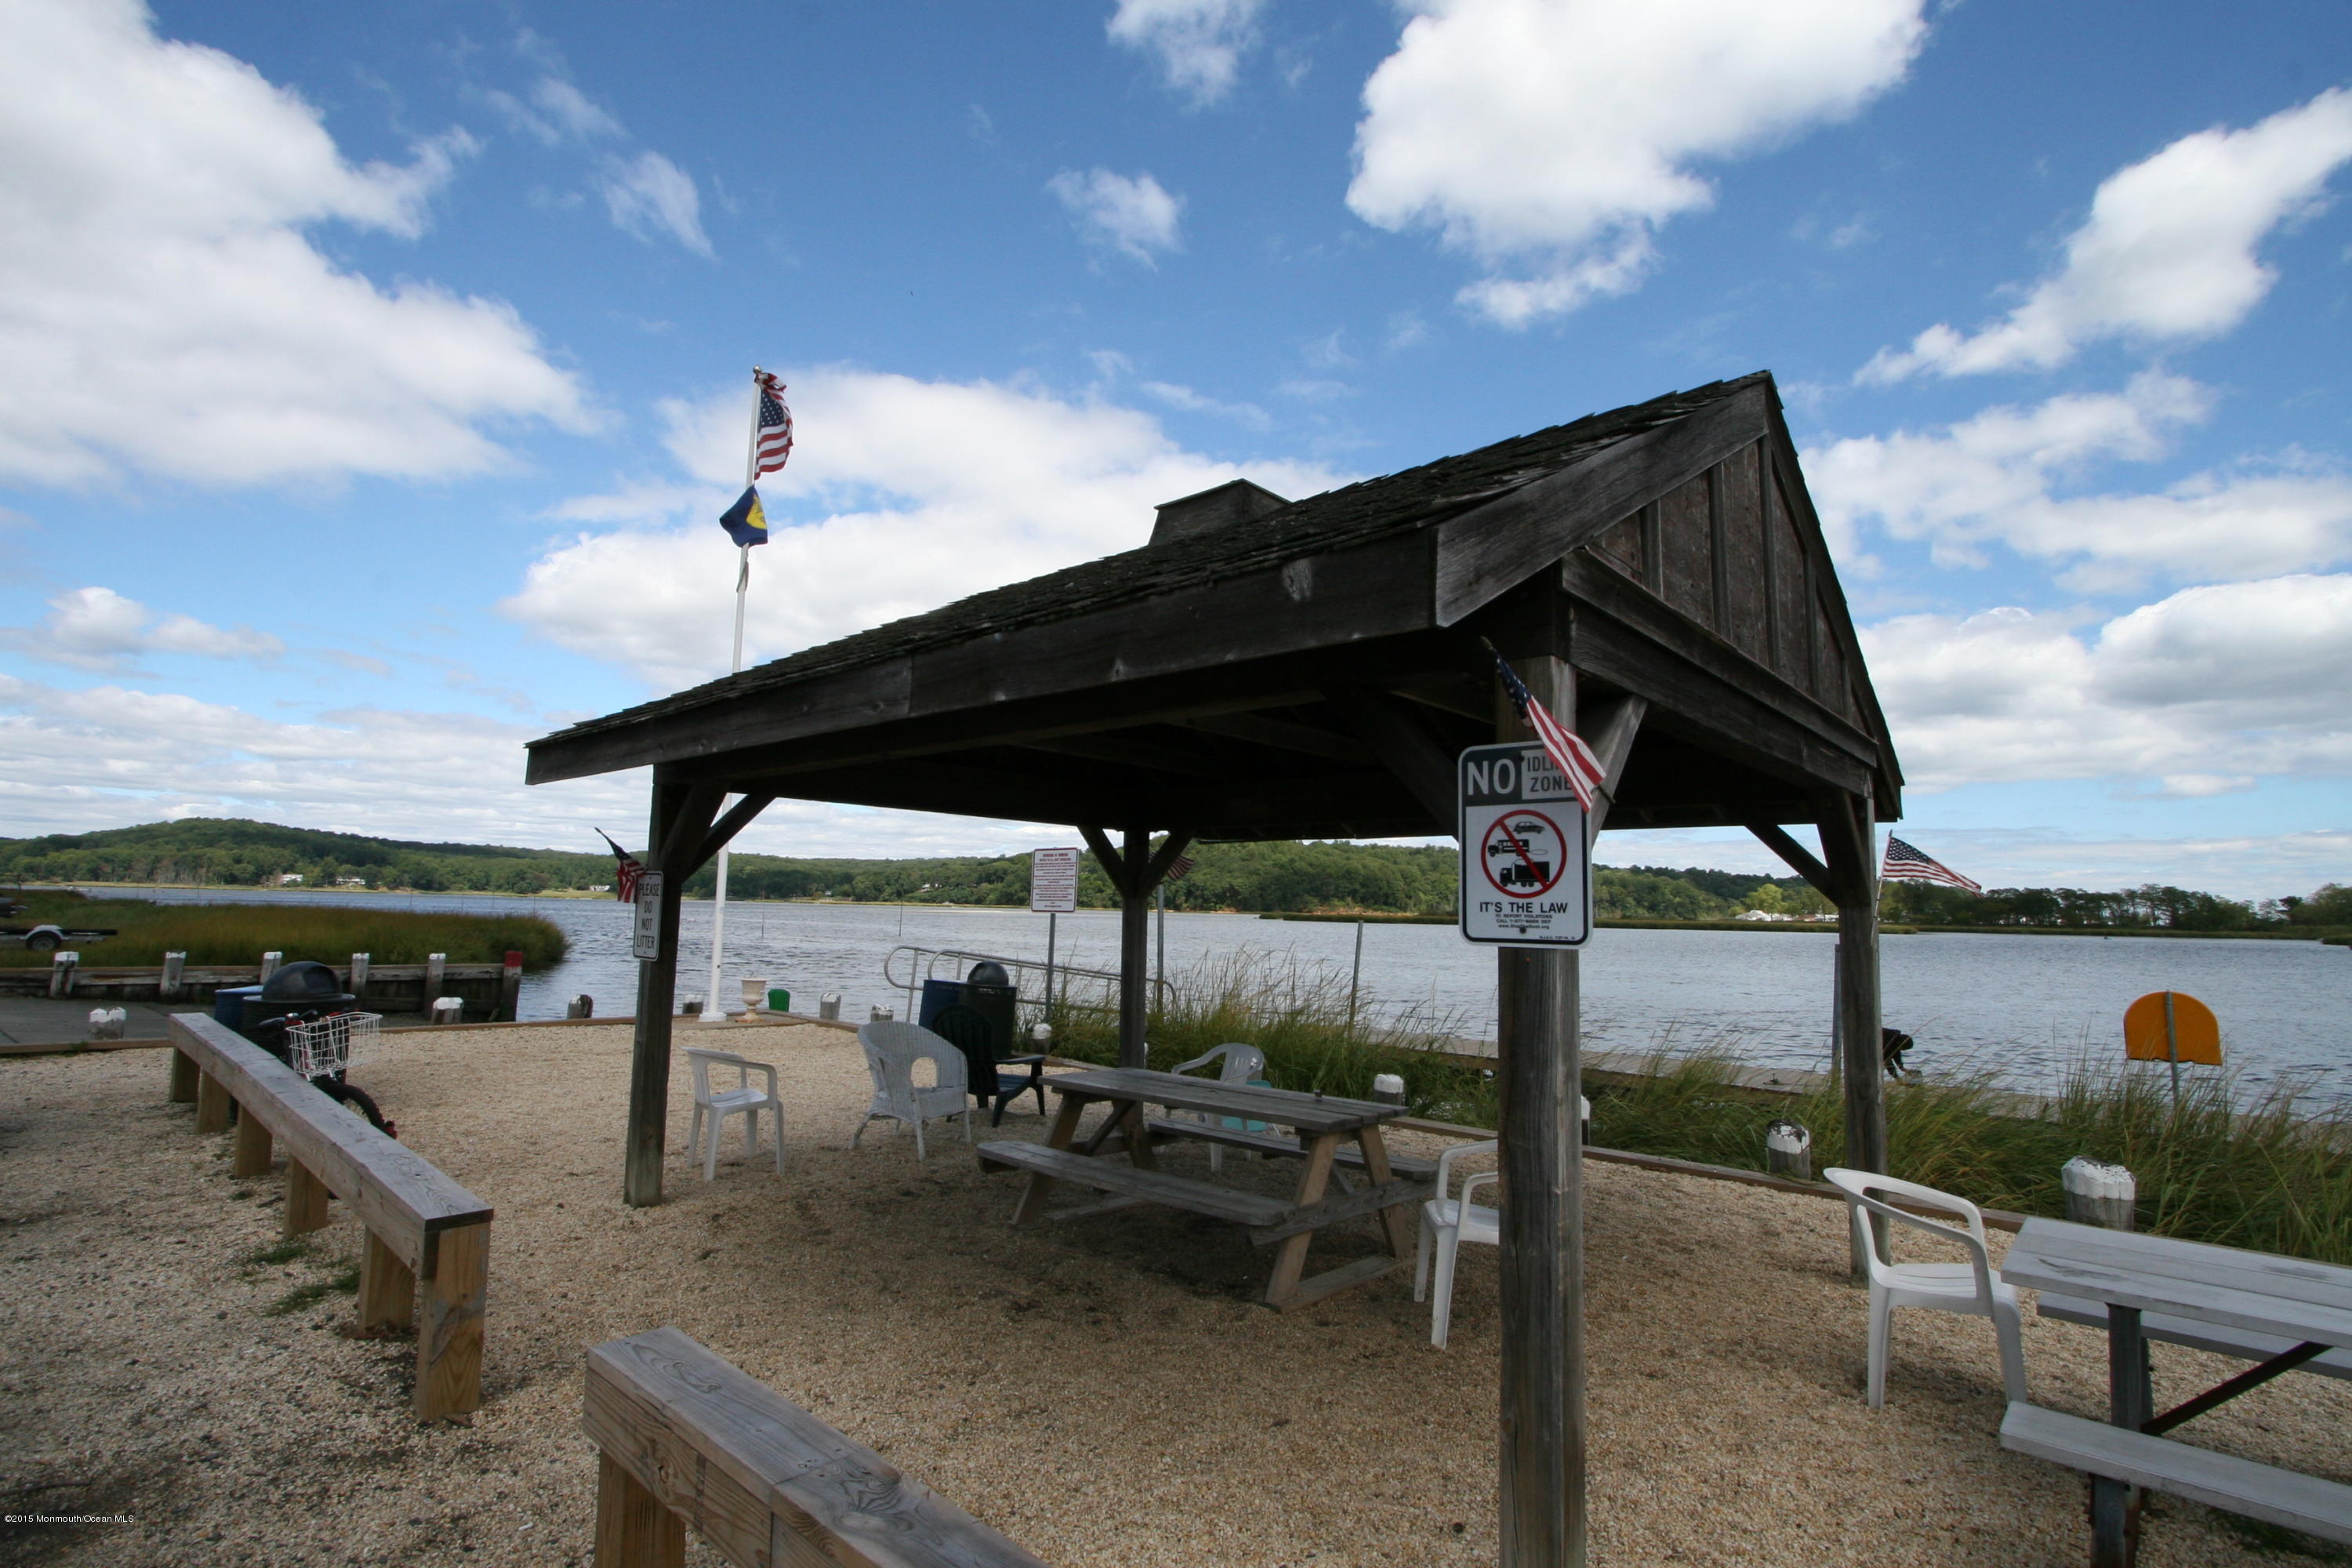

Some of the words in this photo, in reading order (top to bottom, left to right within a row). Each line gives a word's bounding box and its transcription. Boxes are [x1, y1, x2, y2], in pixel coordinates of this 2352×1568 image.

[1527, 756, 1559, 772] IDLI
[1467, 758, 1516, 796] NO
[1530, 775, 1572, 793] ZONE
[640, 883, 659, 896] PLEASE
[644, 901, 652, 913] DO
[1479, 902, 1503, 913] IT'S
[1508, 902, 1534, 913] THE
[1540, 902, 1568, 913] LAW
[641, 918, 652, 931] NOT
[637, 935, 655, 949] LITTER
